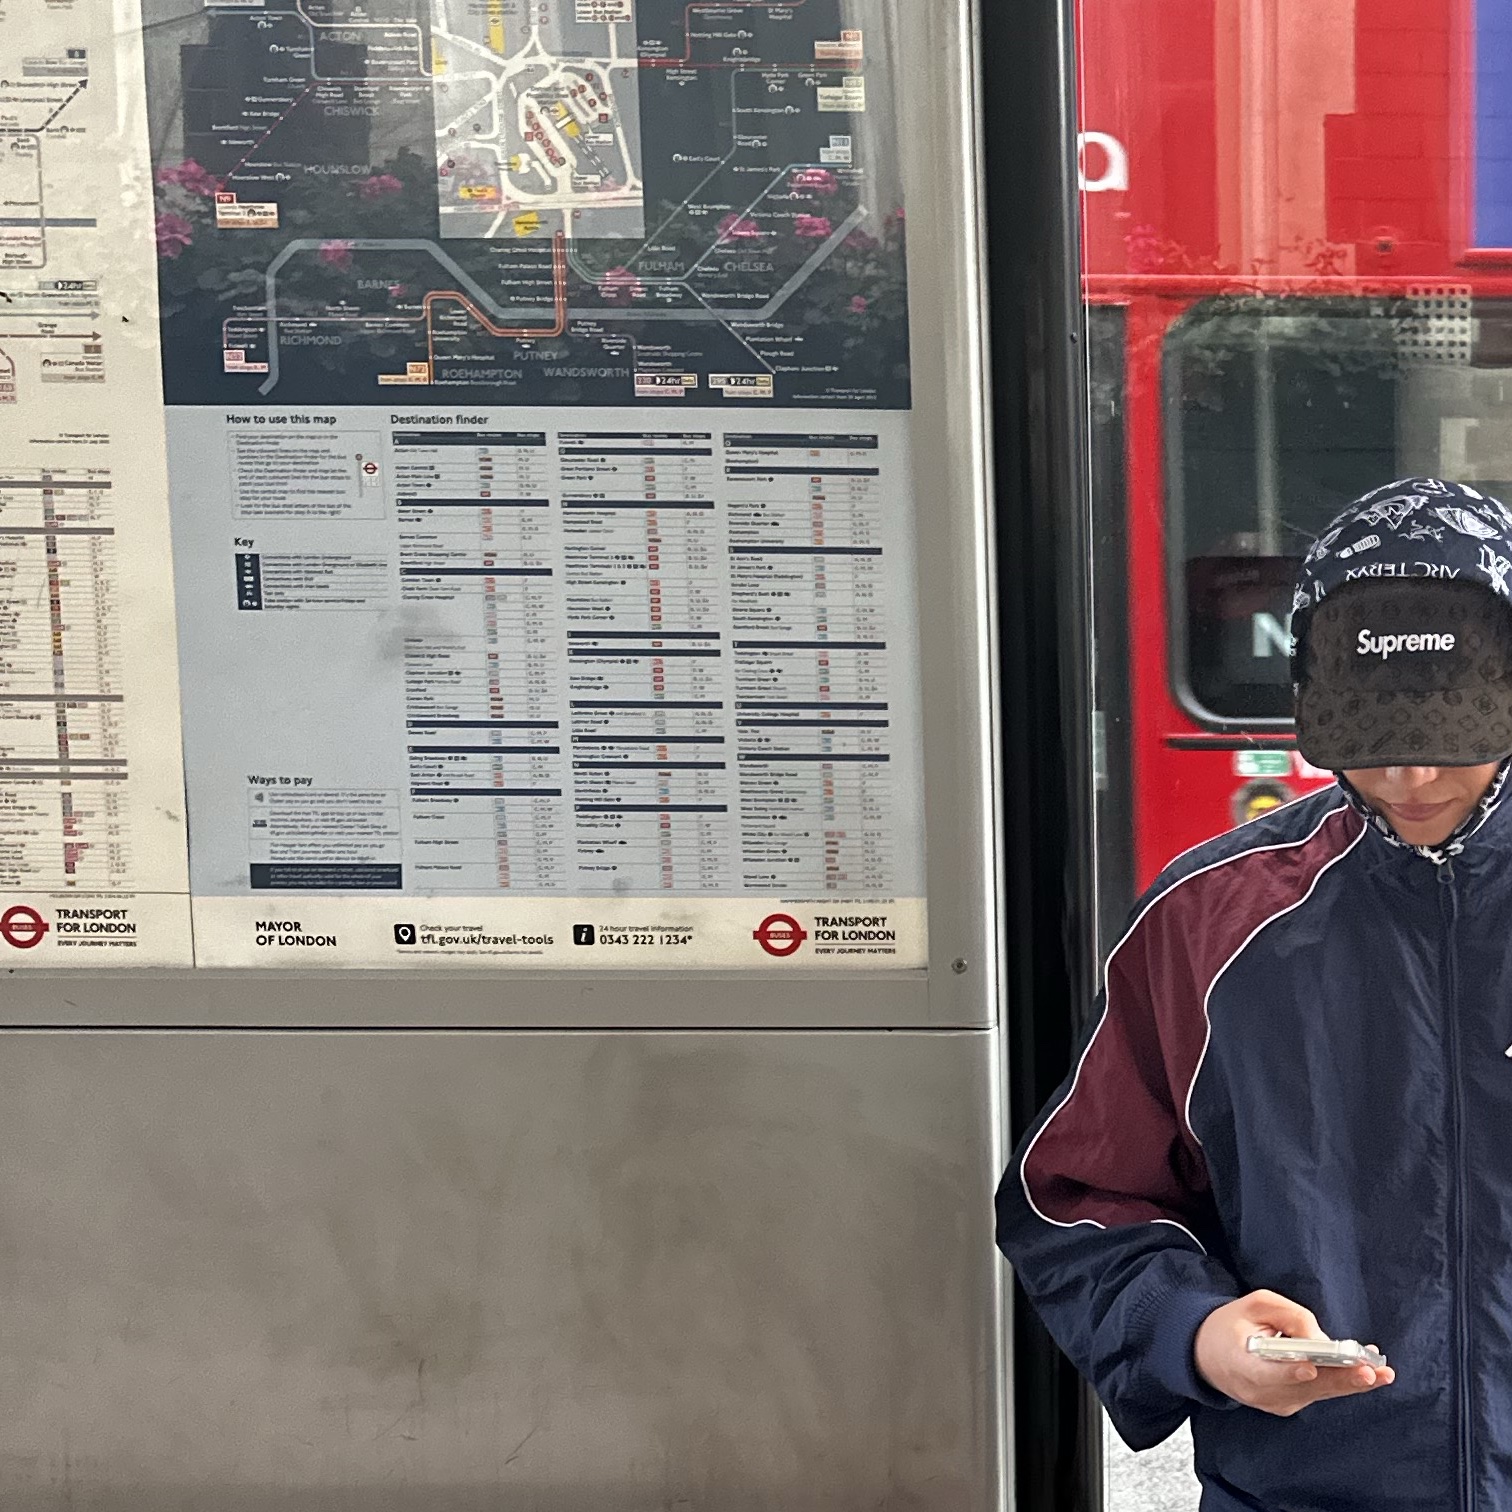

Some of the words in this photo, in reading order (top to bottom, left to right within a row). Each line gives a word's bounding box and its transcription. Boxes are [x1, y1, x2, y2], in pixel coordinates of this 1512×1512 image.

[319, 32, 362, 41] ACTON
[324, 106, 380, 116] CHISWICK
[638, 261, 684, 272] FULHAM
[724, 261, 774, 272] CHELSEA
[280, 335, 342, 345] RICHMOND
[513, 351, 558, 361] PUTNEY
[442, 369, 522, 379] ROEHAMPTON
[544, 367, 630, 378] WANDSWORTH
[661, 377, 681, 386] 24hr
[735, 377, 757, 386] 24hr
[226, 414, 250, 424] How
[253, 415, 266, 424] to
[268, 416, 287, 424] use
[289, 415, 311, 424] this
[313, 416, 337, 426] map
[391, 414, 453, 424] Destination
[456, 414, 489, 424] finder
[234, 537, 254, 548] Key
[1357, 628, 1456, 660] Supreme
[247, 776, 276, 786] Ways
[279, 776, 291, 785] to
[294, 777, 313, 786] pay
[56, 908, 128, 920] TRANSPORT
[814, 916, 887, 927] TRANSPORT
[57, 923, 81, 933] FOR
[84, 923, 137, 933] LONDON
[255, 921, 303, 933] MAYOR
[445, 926, 461, 934] your
[420, 934, 554, 947] tfl.gov.uk/travel-tools
[600, 935, 629, 945] 0343
[632, 935, 655, 945] 222
[815, 930, 839, 941] FOR
[842, 930, 896, 941] LONDON
[255, 935, 275, 947] OF
[278, 935, 337, 947] LONDON
